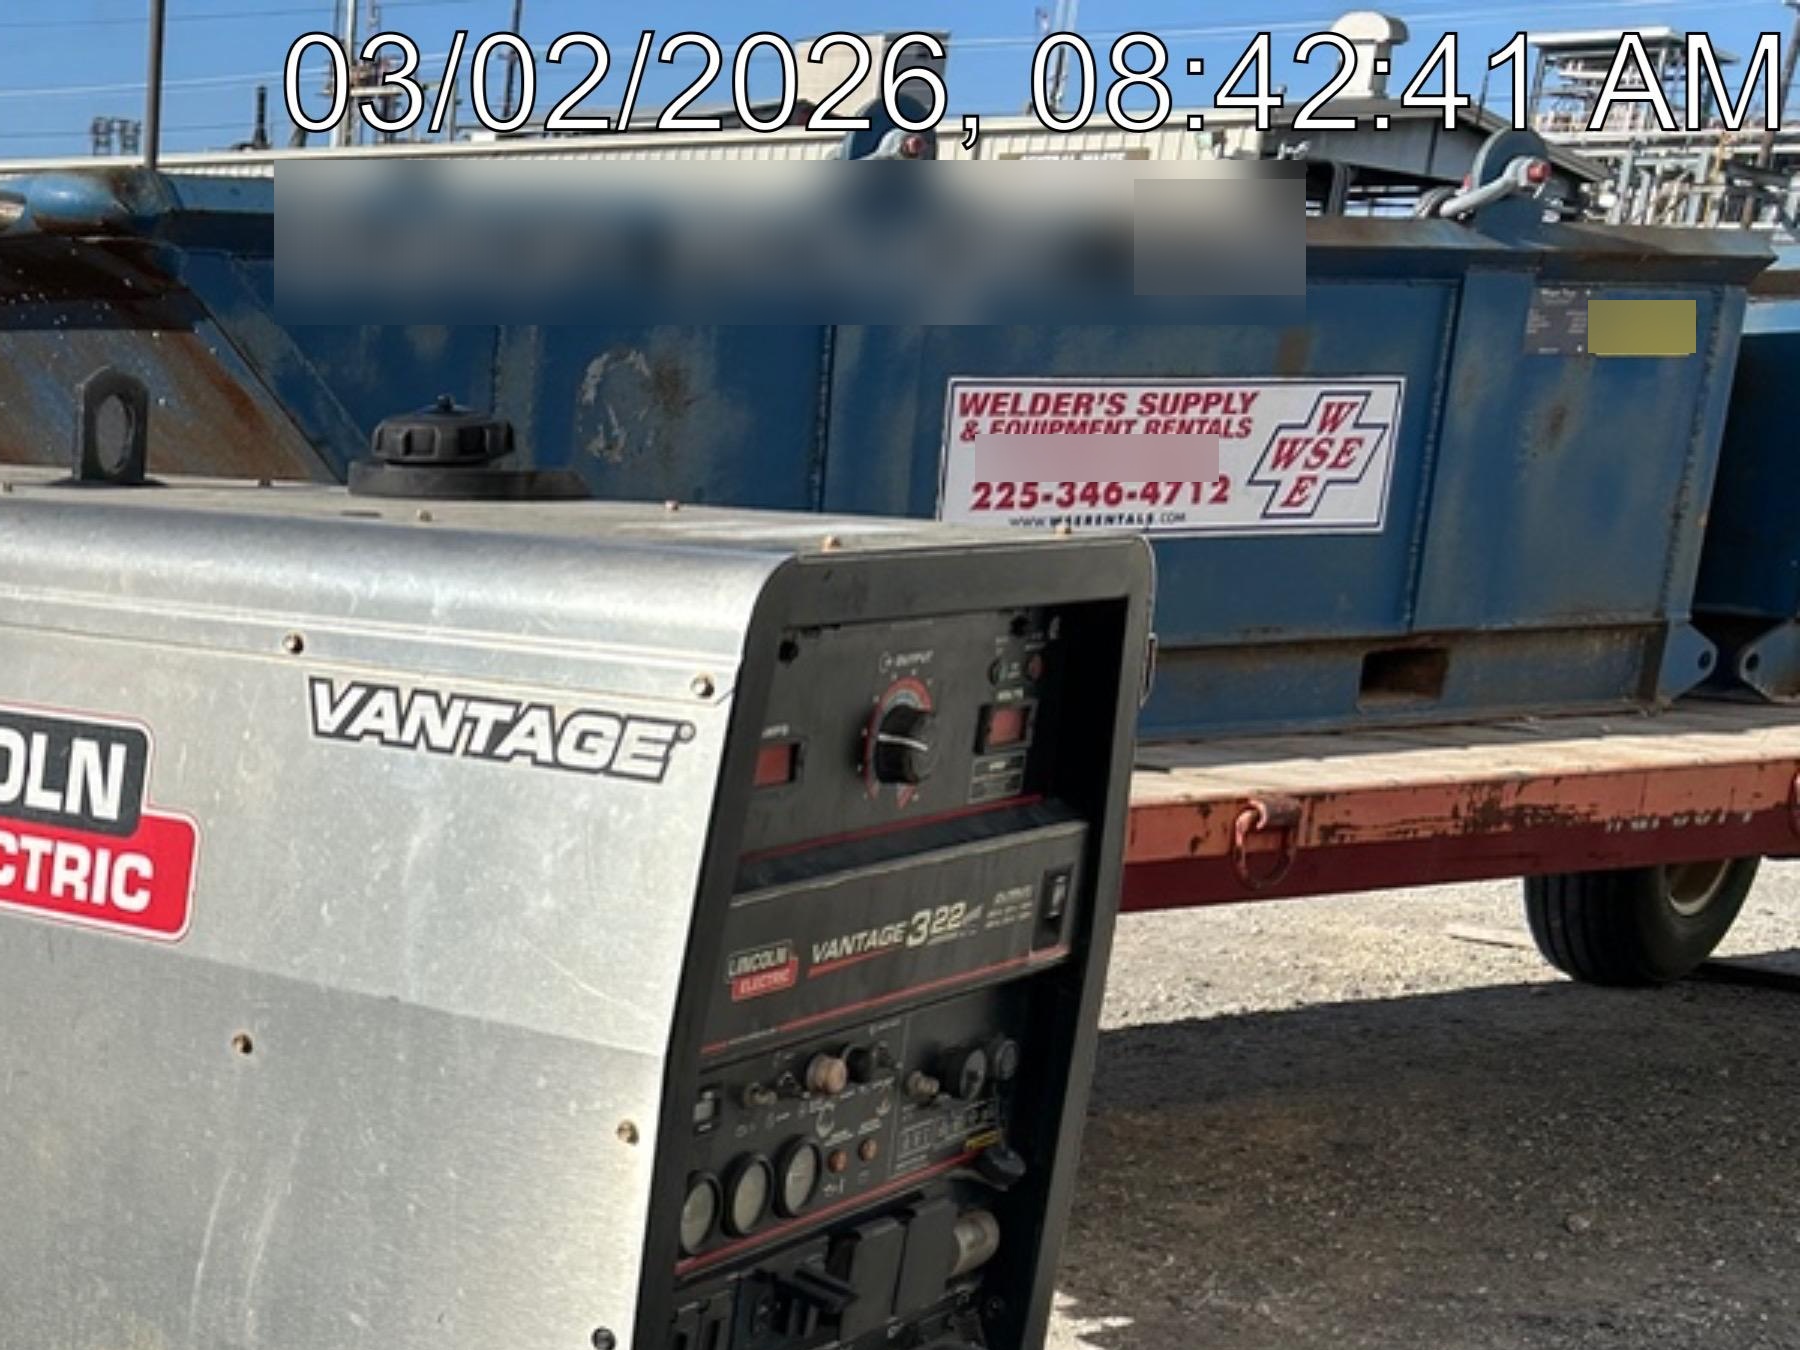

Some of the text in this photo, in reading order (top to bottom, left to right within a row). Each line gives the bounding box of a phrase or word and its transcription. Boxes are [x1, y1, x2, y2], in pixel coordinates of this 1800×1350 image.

[958, 391, 1260, 417] WELDER'S SUPPLY
[960, 420, 981, 442] &
[1144, 417, 1254, 438] RENTALS
[1270, 437, 1365, 470] WSE
[970, 475, 1232, 511] 225-346-4712
[811, 921, 908, 964] VANTAGE
[907, 902, 967, 947] 322
